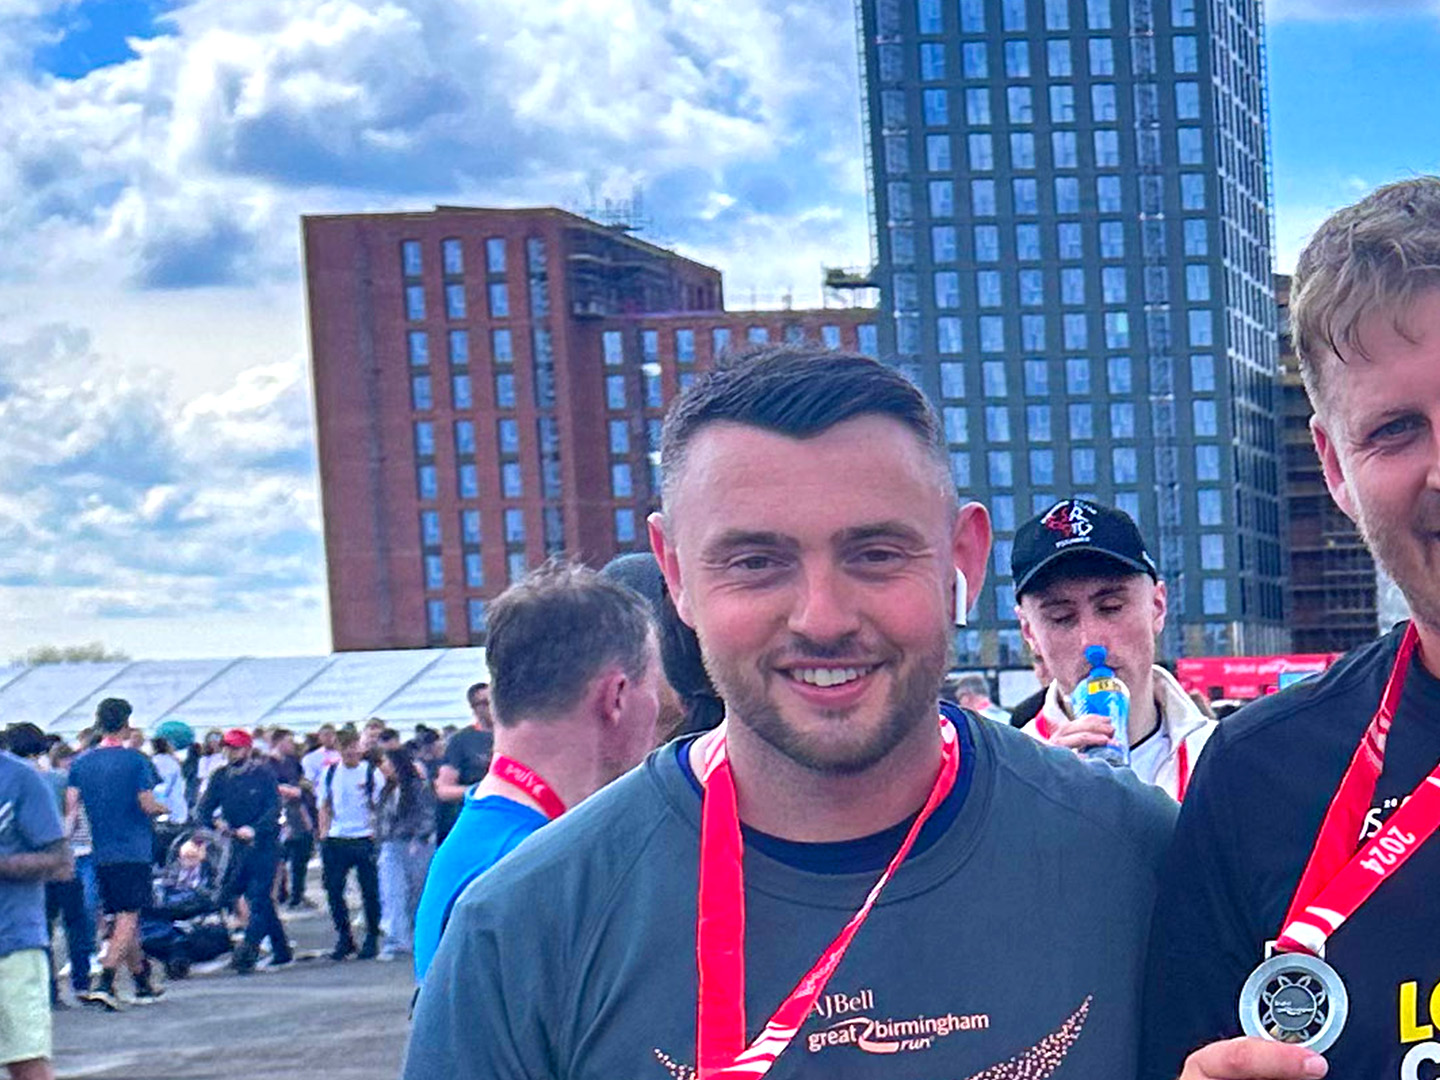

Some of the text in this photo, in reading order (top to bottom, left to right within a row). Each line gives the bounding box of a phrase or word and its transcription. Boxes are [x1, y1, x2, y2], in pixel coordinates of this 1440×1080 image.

[1360, 825, 1416, 875] 2024
[807, 1012, 989, 1053] great birmingham
